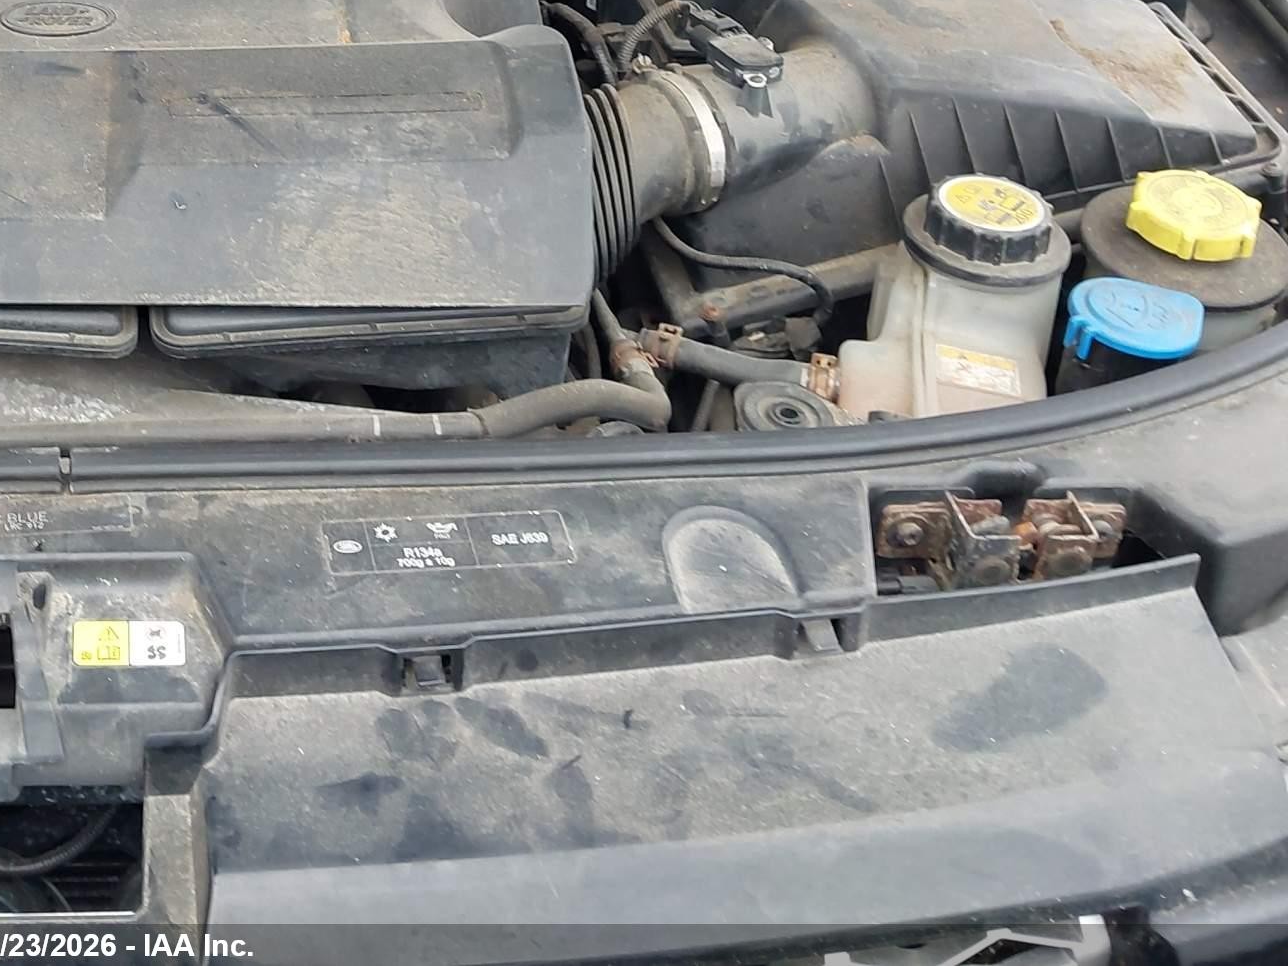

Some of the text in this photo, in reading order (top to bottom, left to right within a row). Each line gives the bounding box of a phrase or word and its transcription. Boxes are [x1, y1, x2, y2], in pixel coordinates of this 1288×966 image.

[24, 5, 78, 16] LAND
[25, 16, 94, 27] ROVER
[7, 511, 48, 524] BLUE
[492, 533, 519, 545] SAE
[403, 547, 443, 559] R134a
